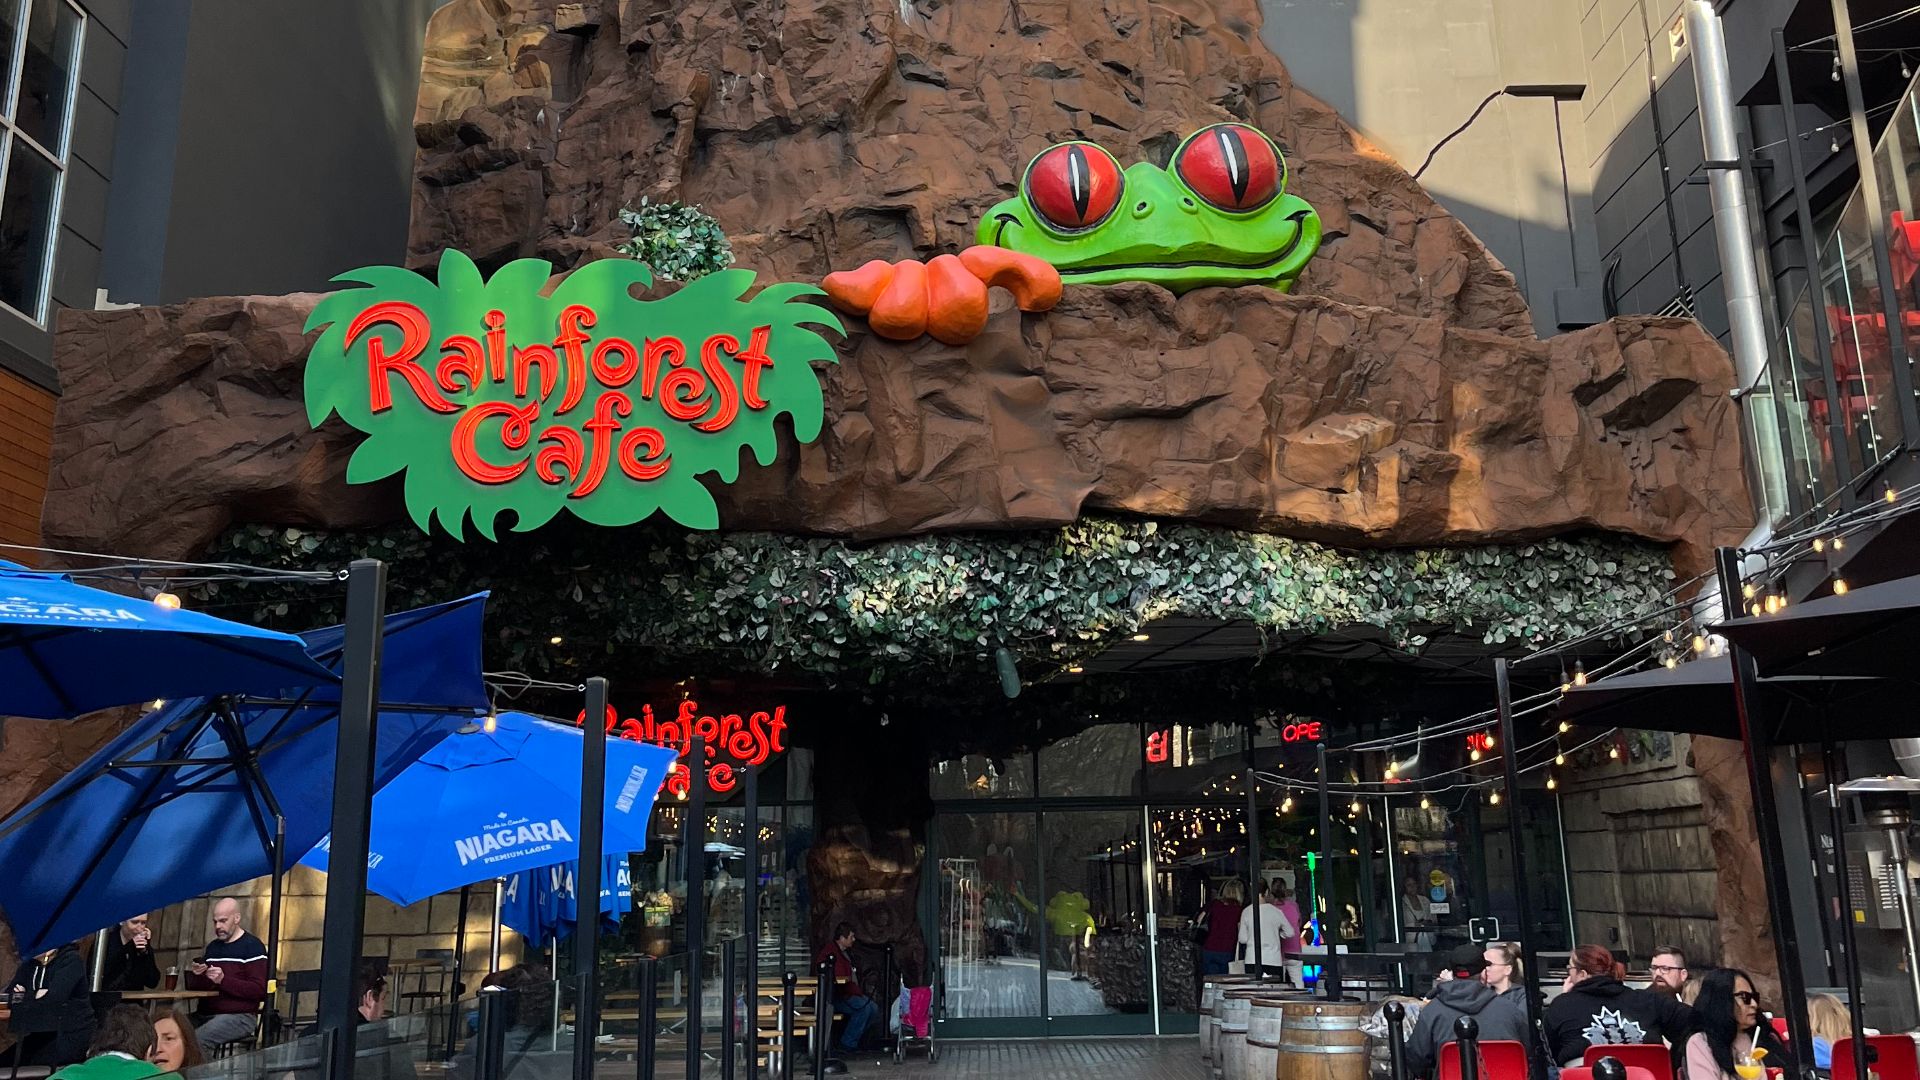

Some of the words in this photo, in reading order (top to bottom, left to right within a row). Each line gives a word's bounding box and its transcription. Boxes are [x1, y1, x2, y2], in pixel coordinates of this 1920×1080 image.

[345, 301, 773, 431] Rainforest
[451, 391, 672, 498] Cafe
[455, 818, 574, 866] NIAGARA
[483, 849, 524, 864] PREMIUM
[525, 843, 553, 855] LAGER
